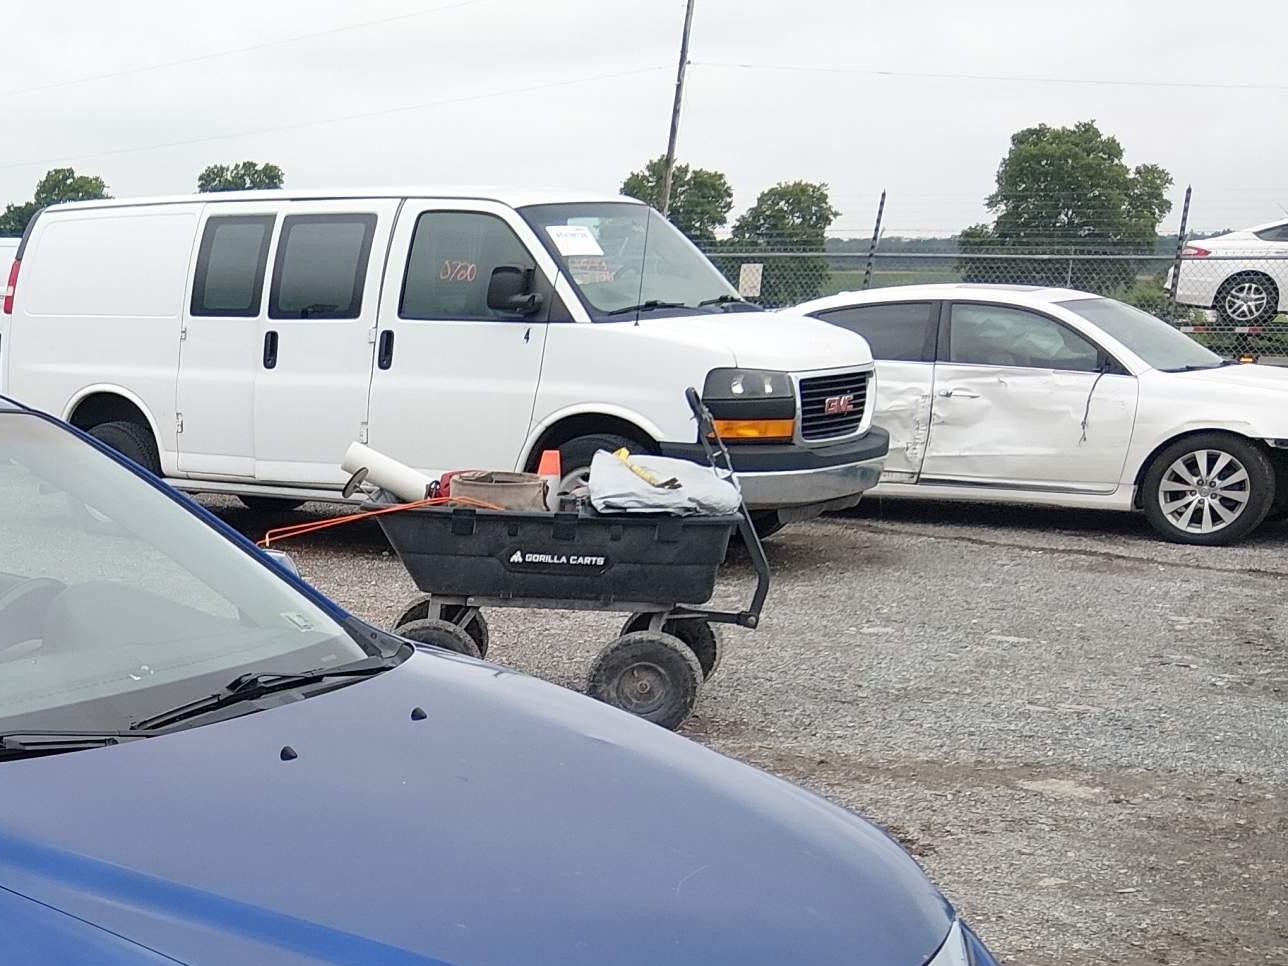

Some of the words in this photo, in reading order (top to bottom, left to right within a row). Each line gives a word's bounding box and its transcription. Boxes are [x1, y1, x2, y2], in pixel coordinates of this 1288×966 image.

[523, 327, 531, 344] 4
[824, 394, 854, 415] GMC
[525, 553, 567, 563] GORILLA
[569, 556, 605, 565] CARTS
